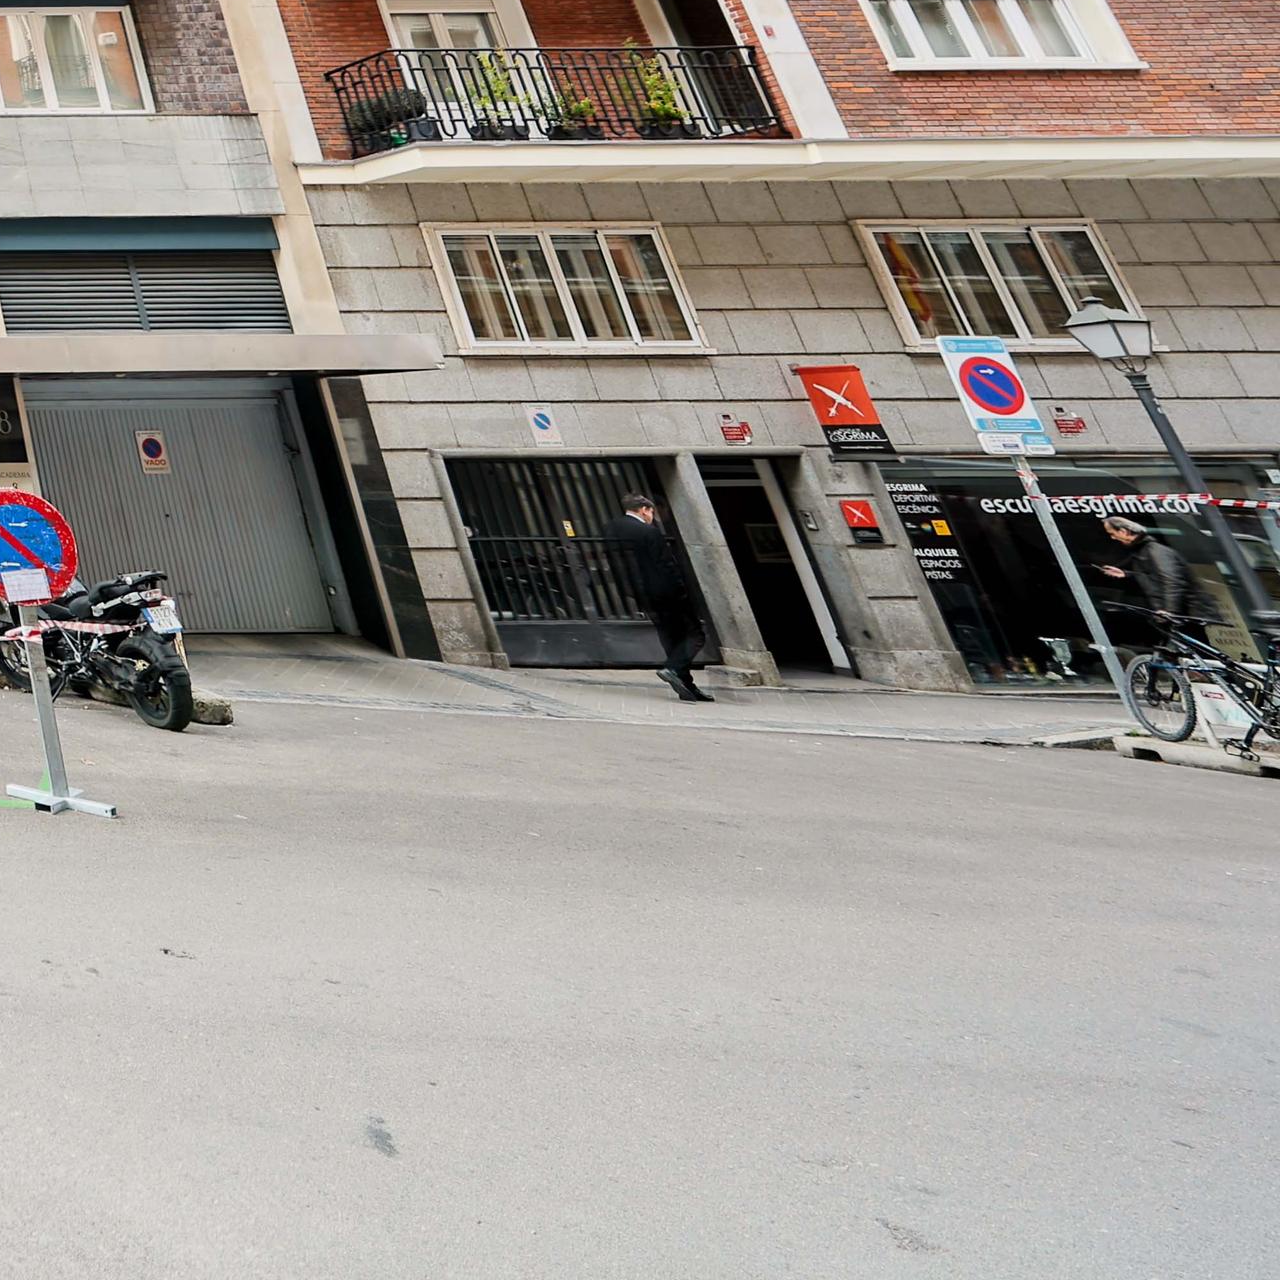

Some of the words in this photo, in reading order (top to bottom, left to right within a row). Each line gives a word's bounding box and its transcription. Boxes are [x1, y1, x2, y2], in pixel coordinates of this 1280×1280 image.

[885, 483, 928, 492] ESGRIMA
[892, 494, 940, 503] DEPORTIVA
[913, 548, 959, 558] ALQUILER
[920, 559, 962, 569] ESPACIOS
[924, 570, 954, 580] PISTAS
